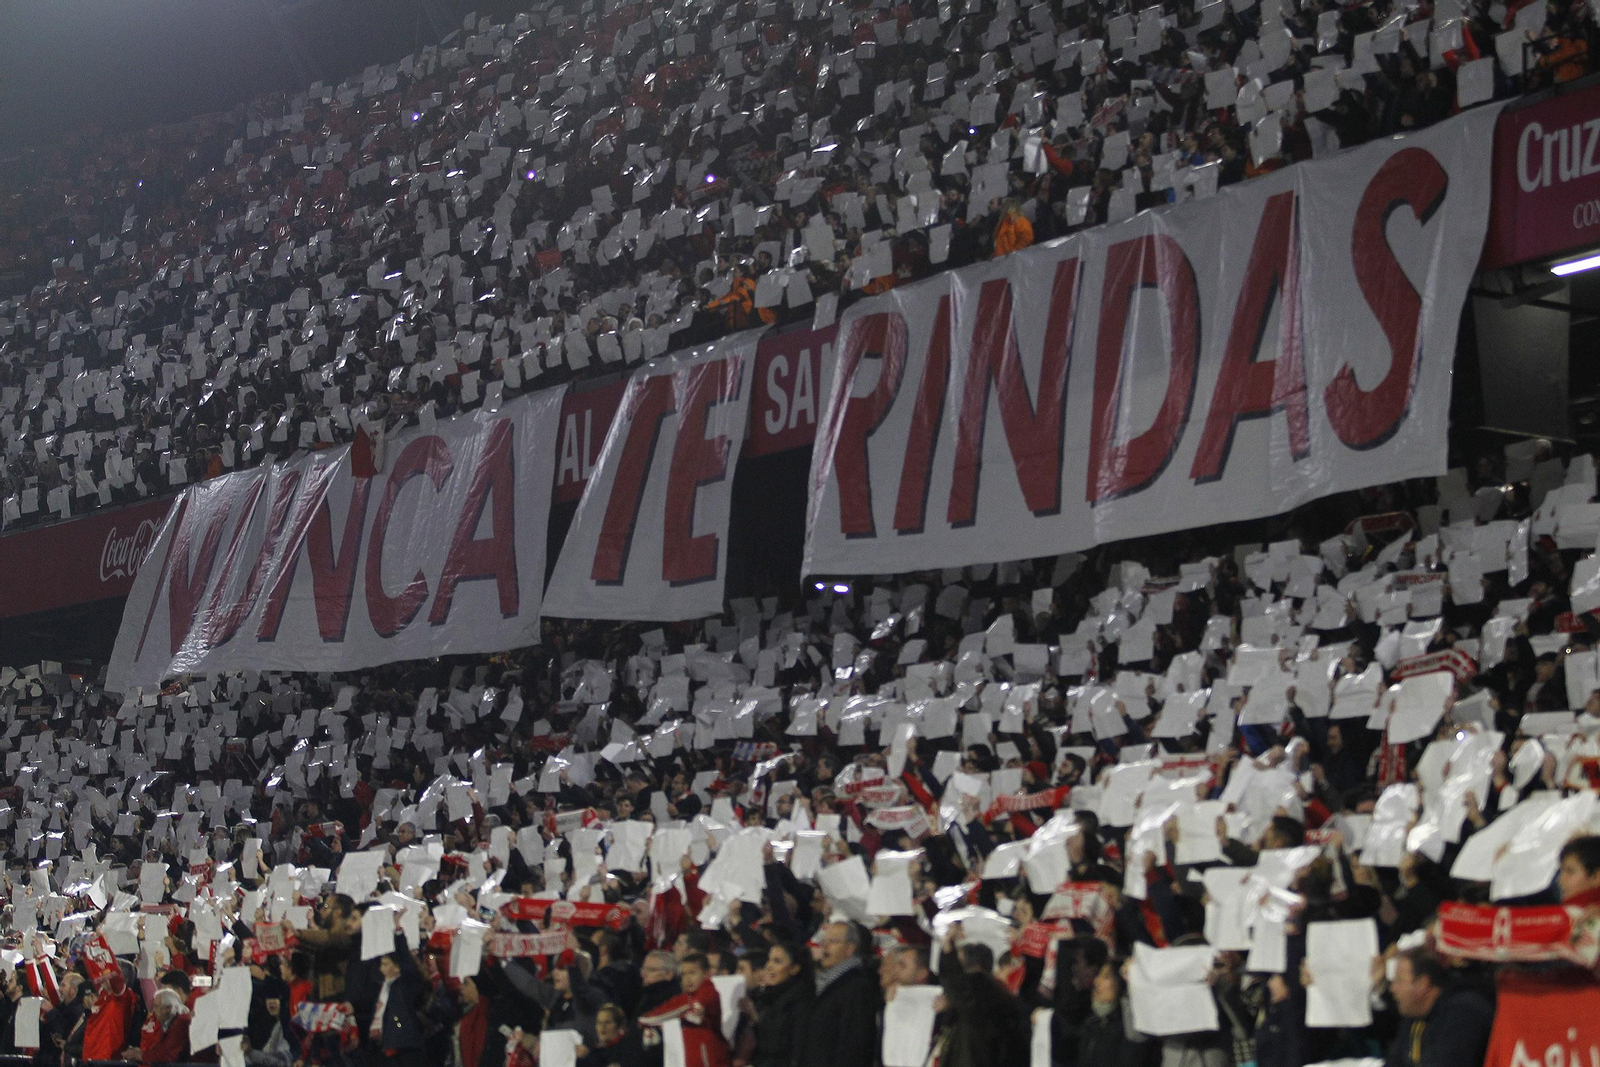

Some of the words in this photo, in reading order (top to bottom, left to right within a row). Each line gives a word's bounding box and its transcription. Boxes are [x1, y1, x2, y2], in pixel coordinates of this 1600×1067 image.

[1516, 118, 1600, 193] Cruz
[134, 417, 520, 662] NUNCA
[590, 354, 746, 588] TE
[814, 146, 1449, 539] RINDAS
[555, 408, 597, 486] AL
